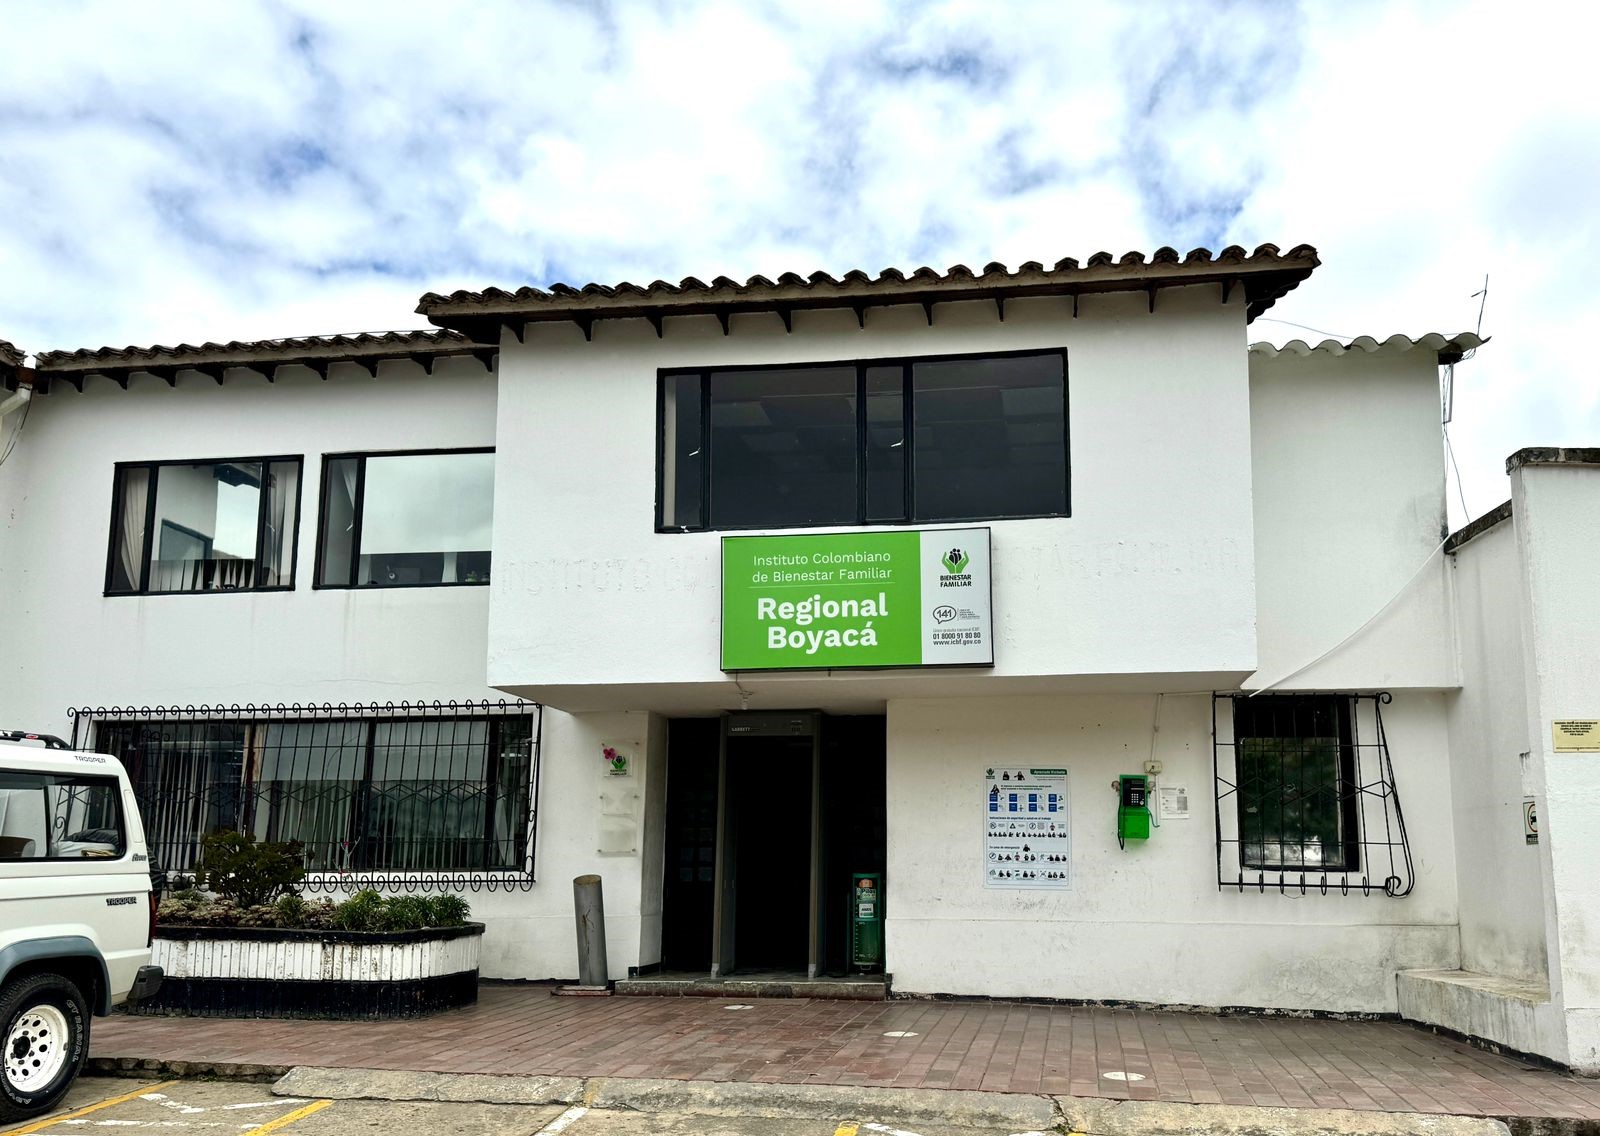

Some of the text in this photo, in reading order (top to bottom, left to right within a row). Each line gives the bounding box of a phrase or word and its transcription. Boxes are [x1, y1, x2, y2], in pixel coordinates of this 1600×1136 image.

[753, 551, 891, 566] Instituto Colombiano
[752, 567, 892, 583] de Bienestar Familiar
[757, 592, 888, 625] Regional
[936, 609, 952, 618] 141
[768, 621, 878, 654] Boyacá
[932, 638, 982, 646] www.icbf.gov.co
[73, 755, 107, 764] TROOPER
[106, 896, 137, 907] TROOPER
